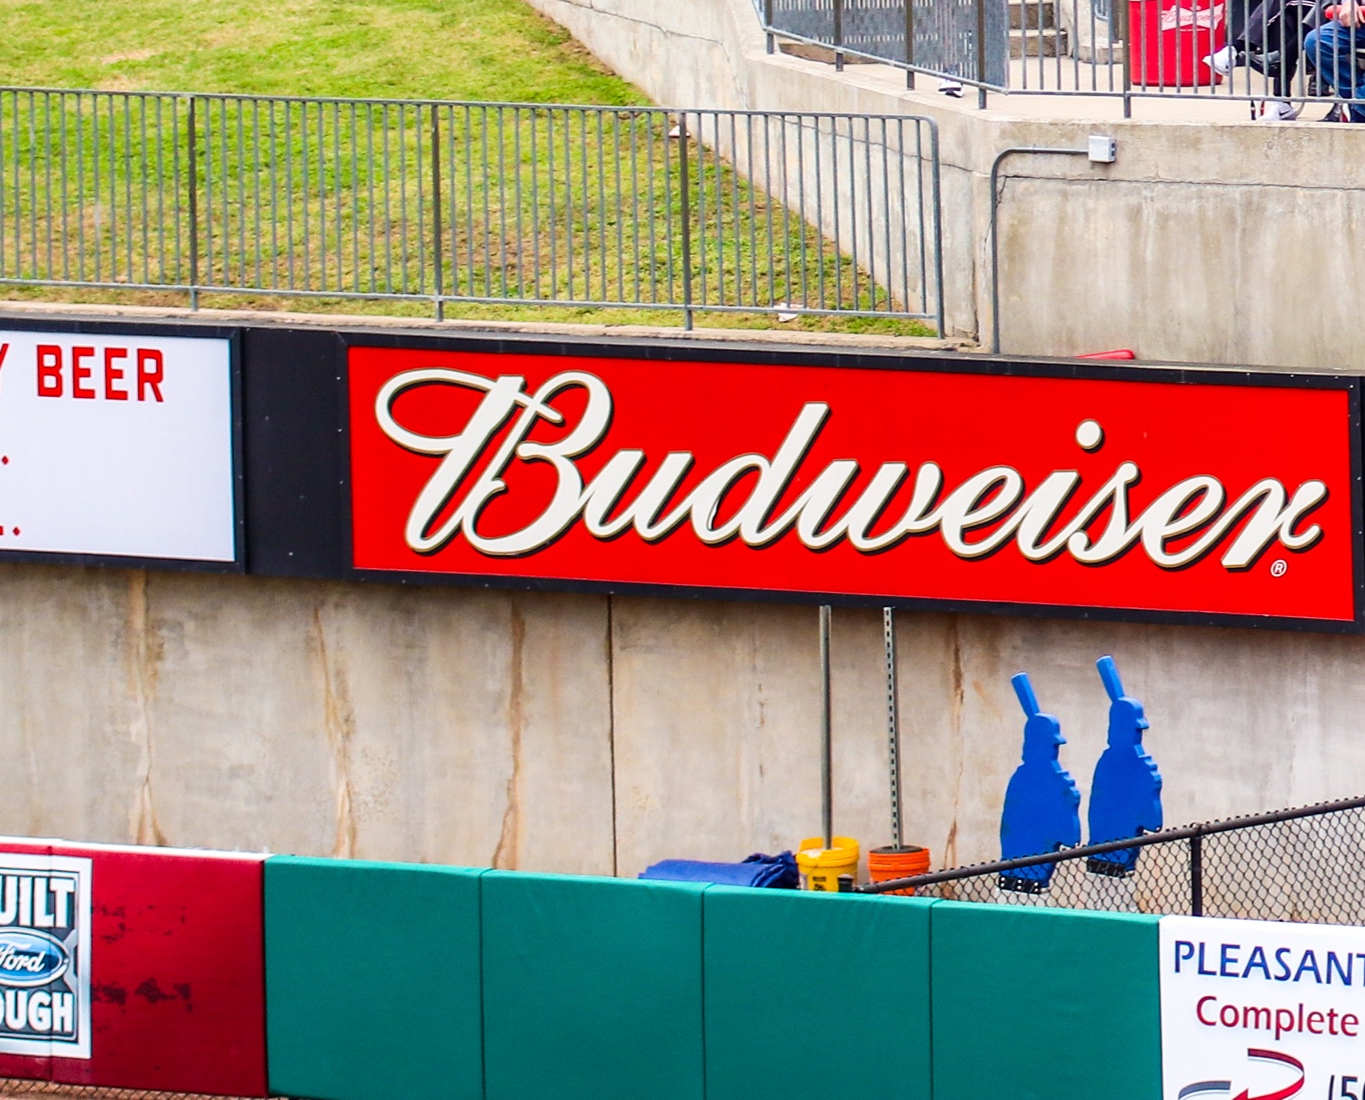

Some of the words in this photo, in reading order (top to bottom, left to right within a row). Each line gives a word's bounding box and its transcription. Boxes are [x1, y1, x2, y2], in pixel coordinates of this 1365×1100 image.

[37, 344, 164, 403] BEER
[374, 368, 1327, 570] Budweiser
[0, 874, 76, 929] UILT
[1196, 995, 1360, 1038] Complete
